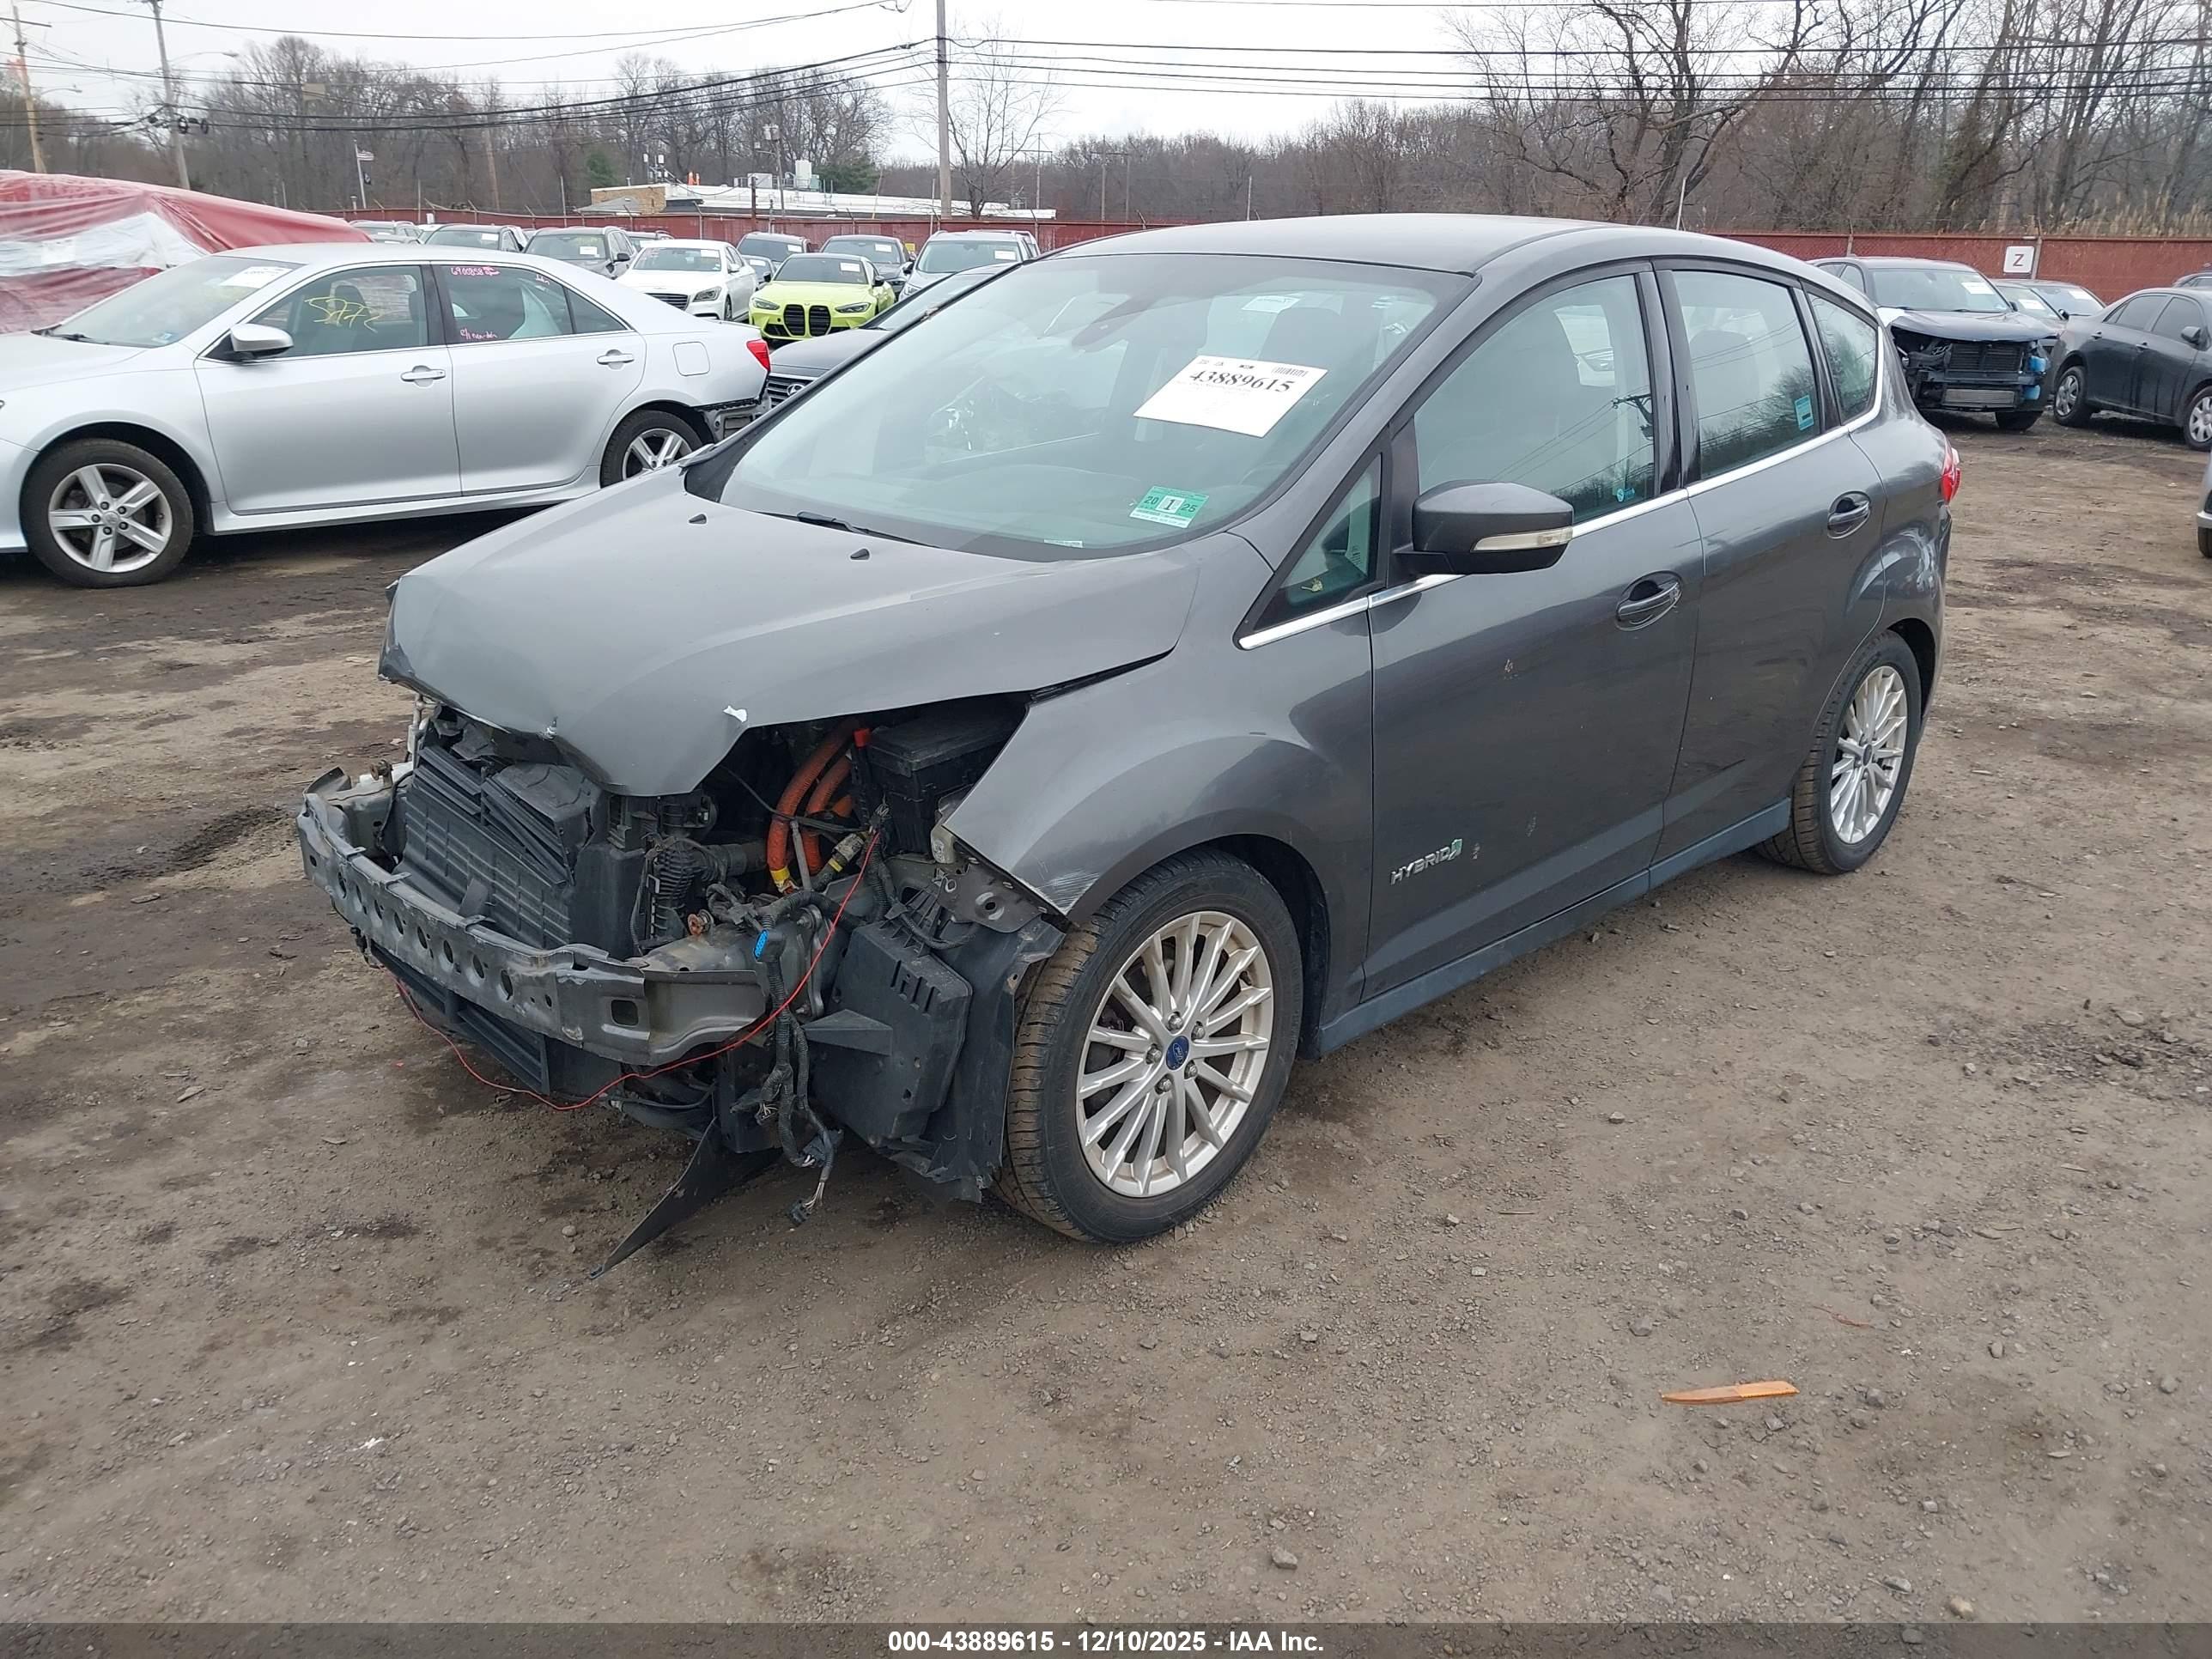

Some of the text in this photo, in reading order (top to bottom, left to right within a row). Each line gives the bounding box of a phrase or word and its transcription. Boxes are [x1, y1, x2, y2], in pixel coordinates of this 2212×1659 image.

[2013, 254, 2024, 266] Z
[1189, 370, 1296, 392] 43889615
[1145, 495, 1197, 513] 20 1 25
[1390, 846, 1451, 885] HYBRID
